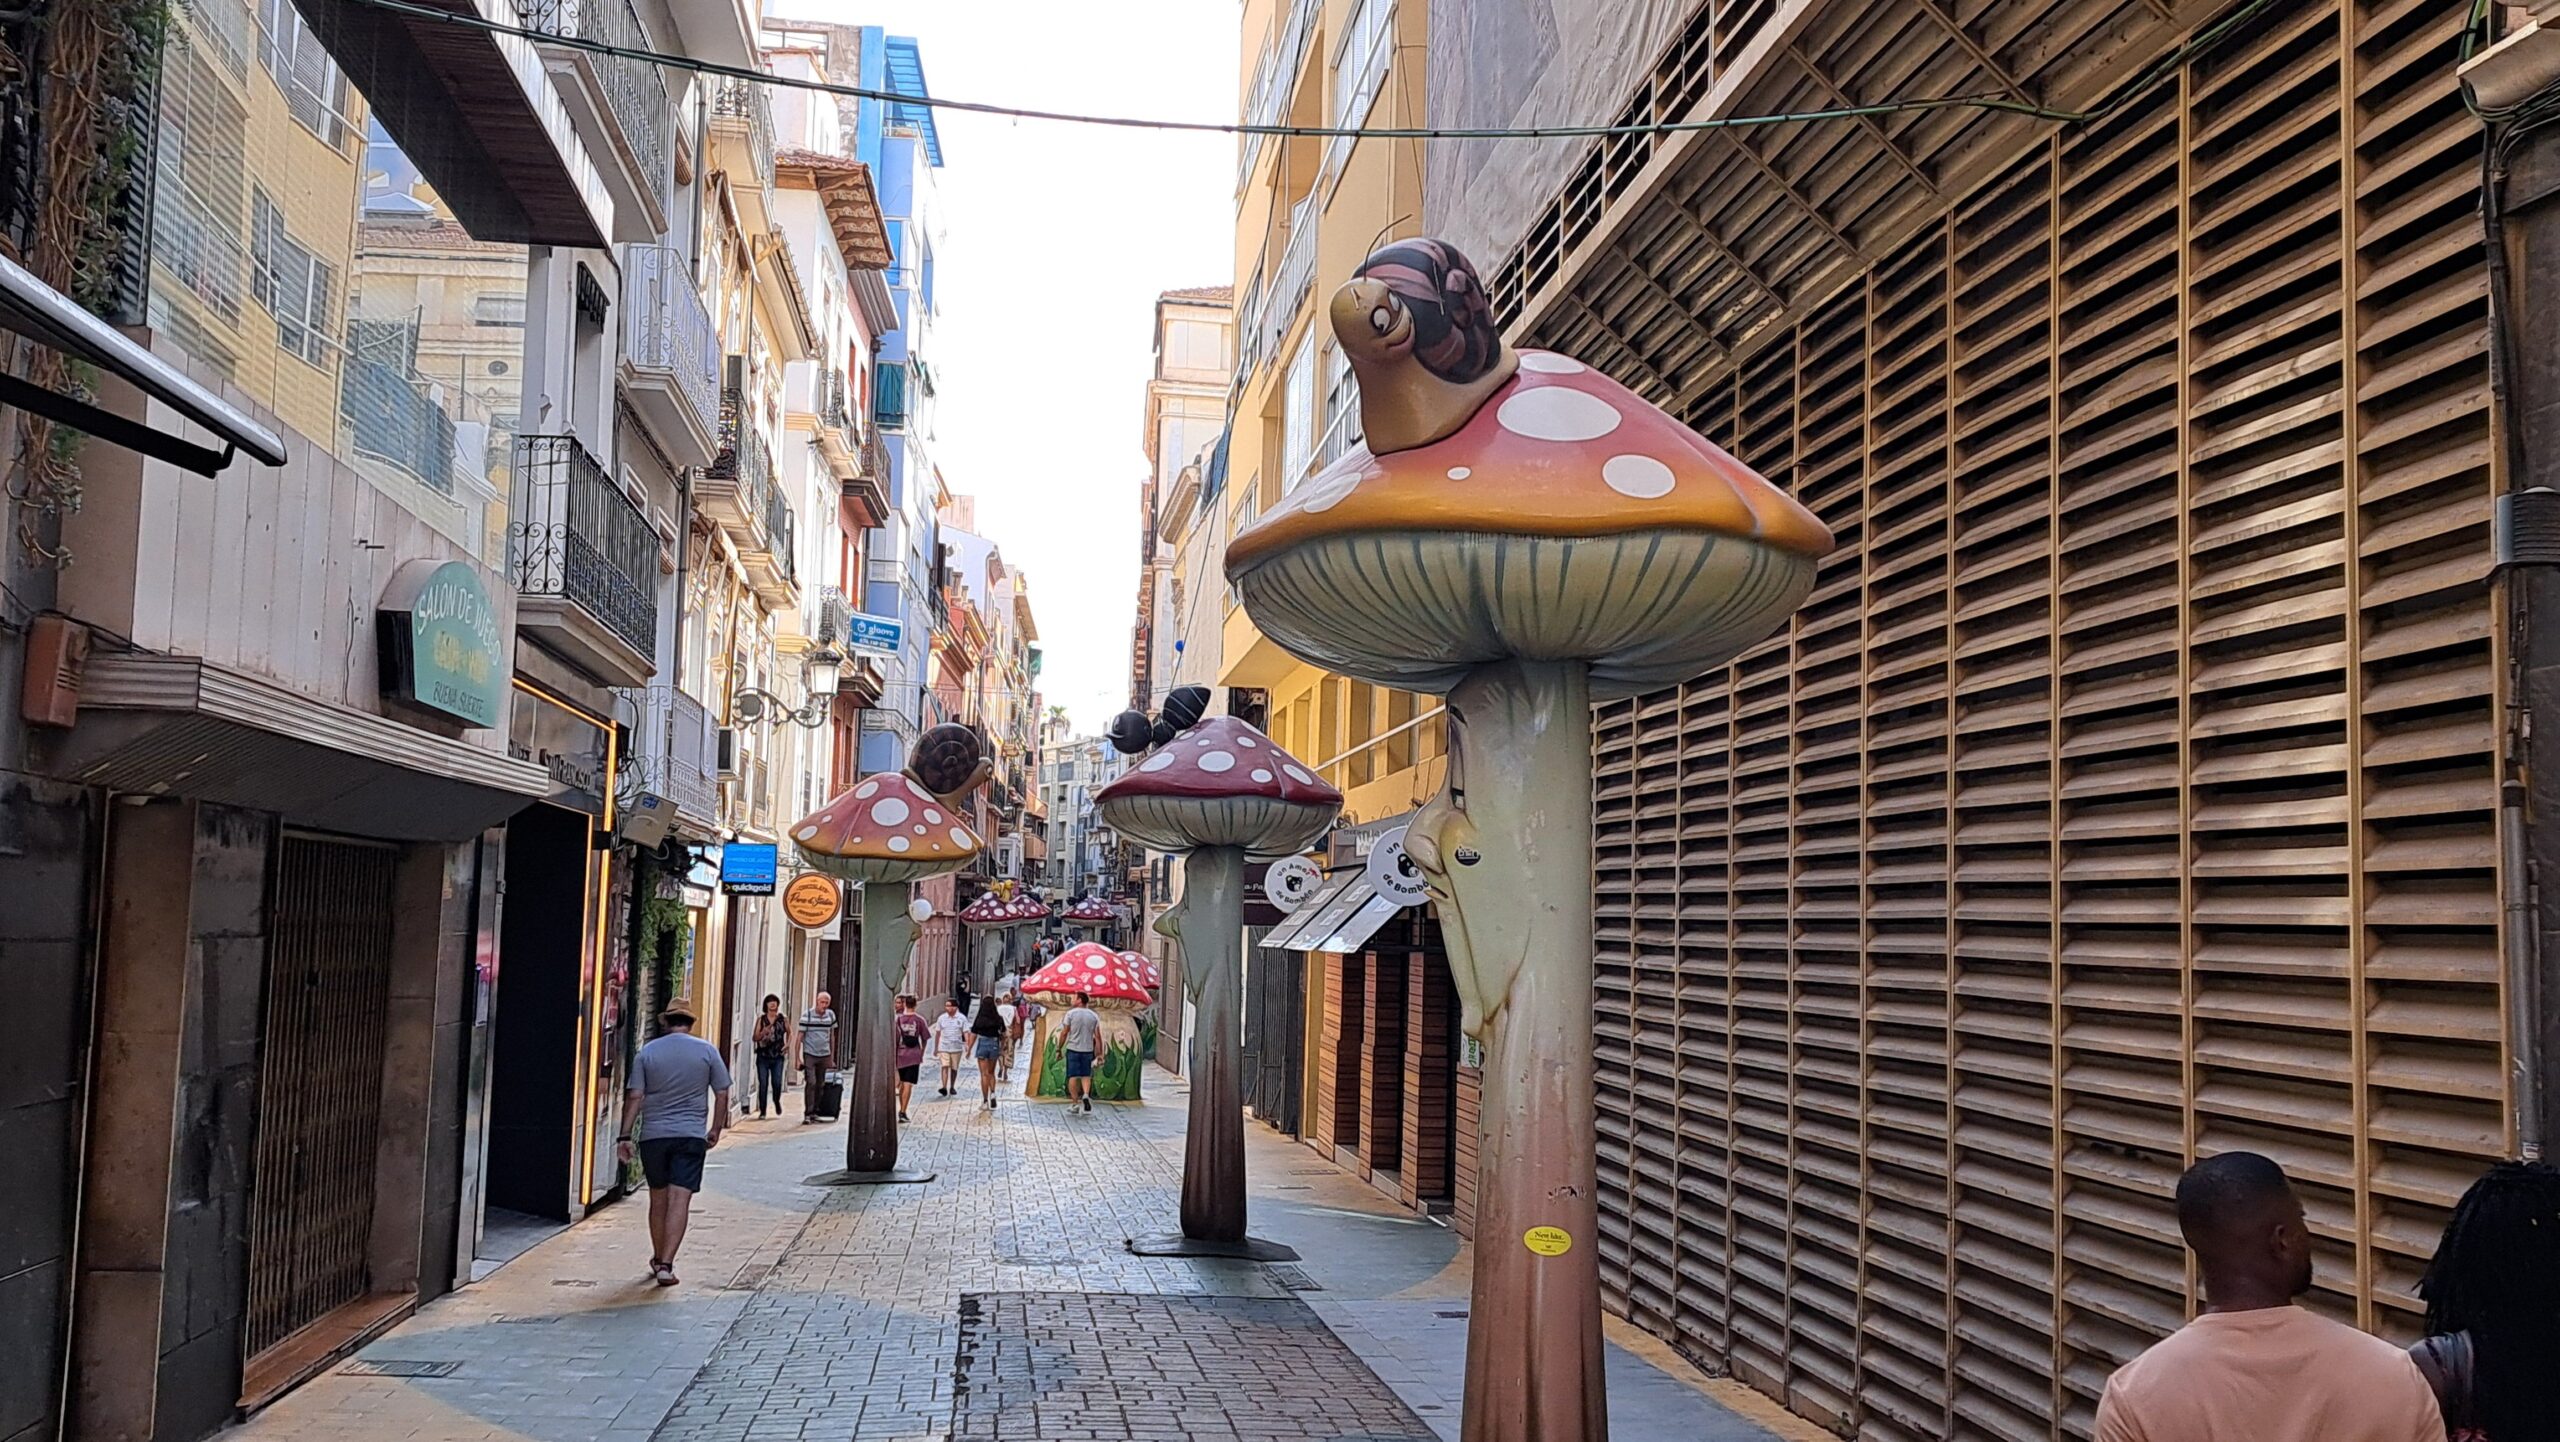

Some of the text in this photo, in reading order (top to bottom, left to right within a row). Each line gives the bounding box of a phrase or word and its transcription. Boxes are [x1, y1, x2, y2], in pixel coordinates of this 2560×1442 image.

[417, 583, 457, 636] SALON
[458, 588, 473, 624] DE
[472, 604, 501, 666] JUEGO
[868, 624, 894, 638] gloove
[433, 681, 485, 719] BUENA SUERTE
[1386, 842, 1400, 854] un
[1277, 867, 1287, 877] un
[731, 883, 772, 893] quickgold
[1382, 873, 1430, 895] de Bombó
[1275, 890, 1285, 899] de
